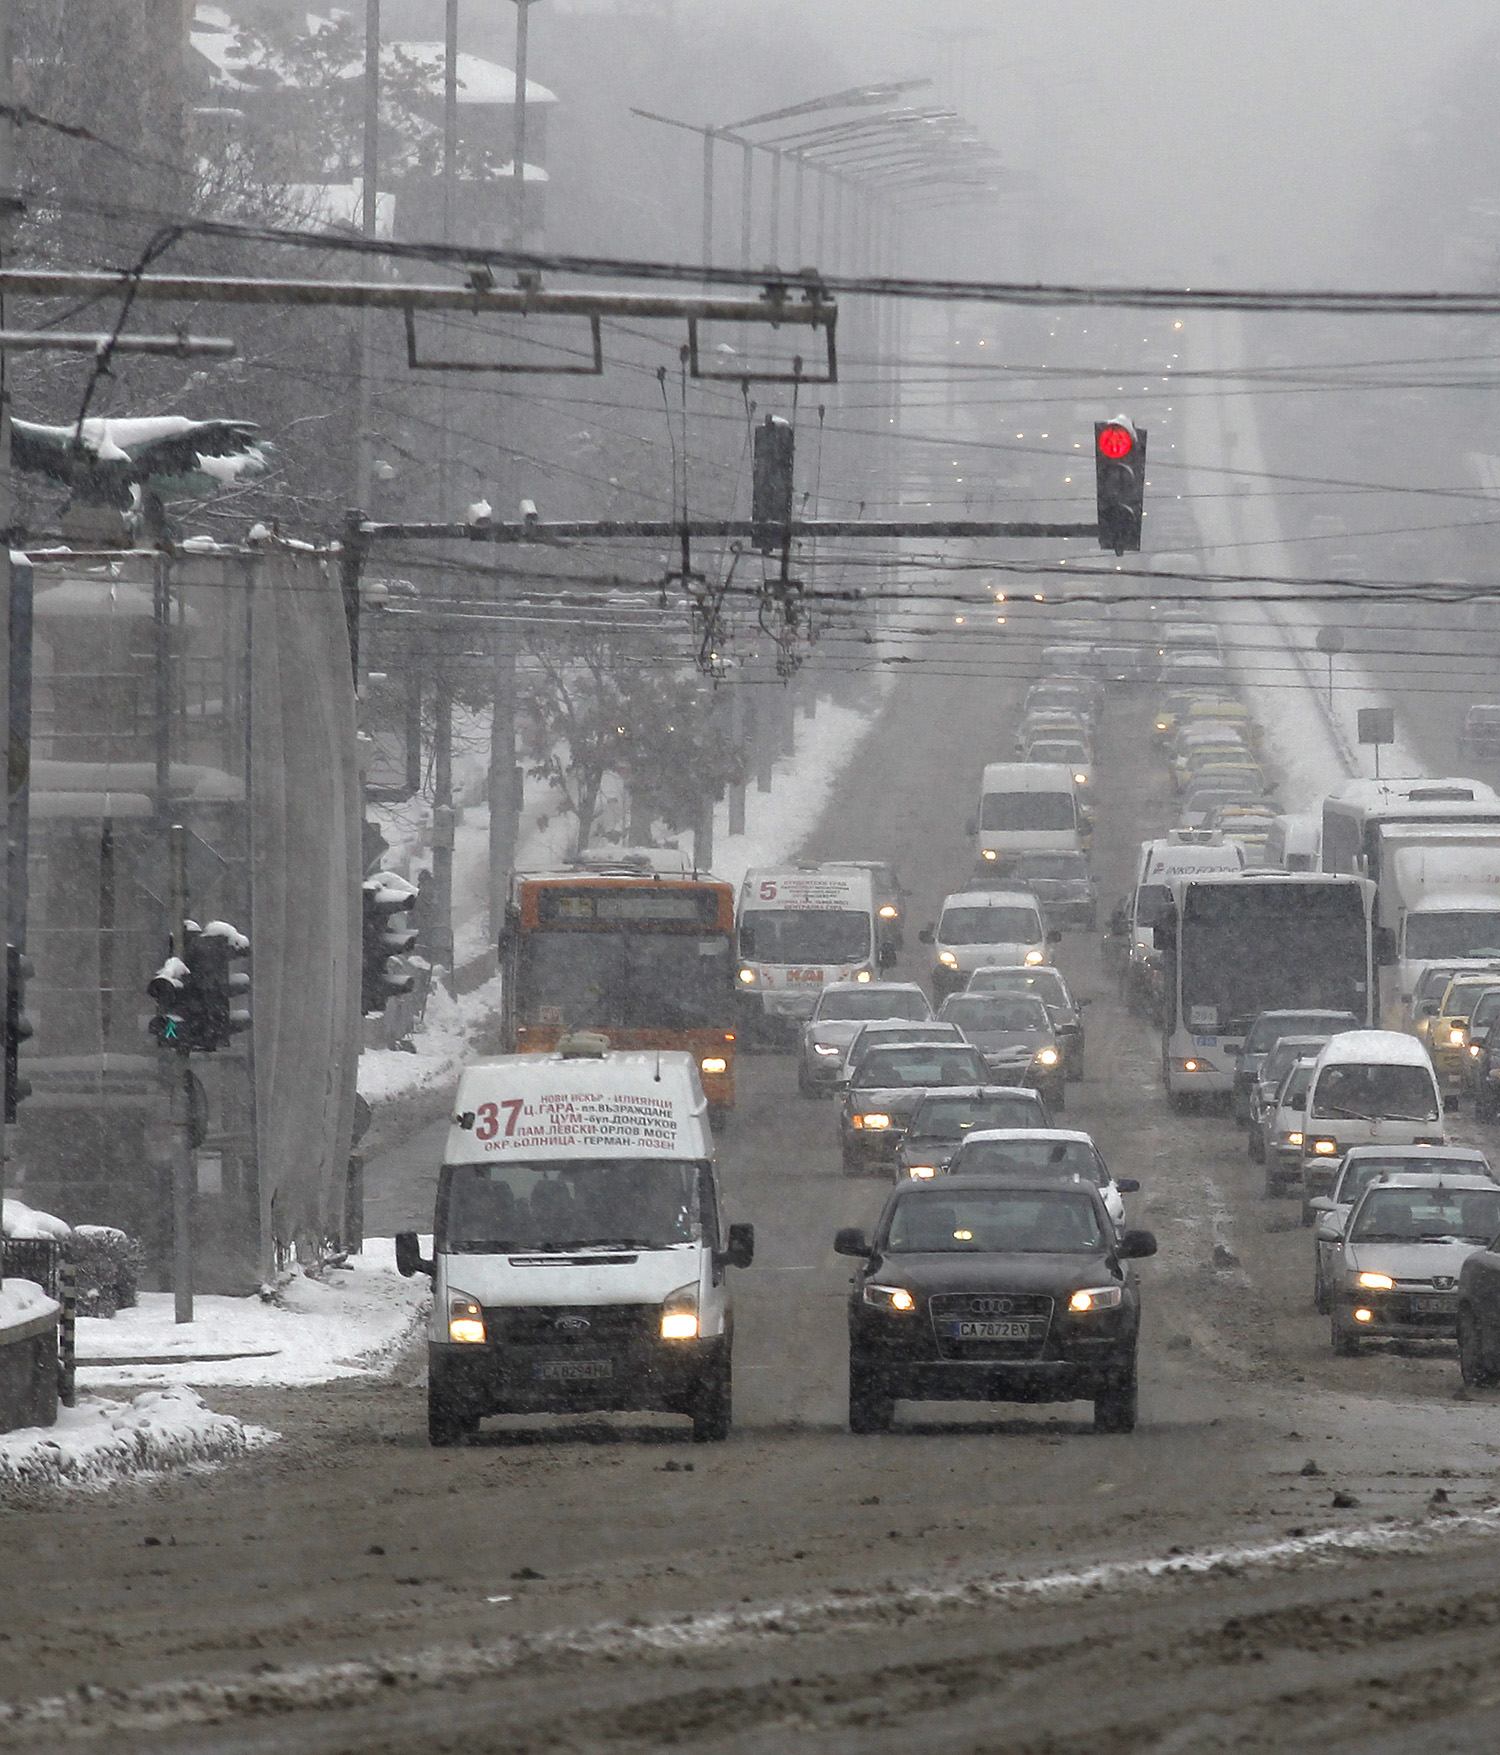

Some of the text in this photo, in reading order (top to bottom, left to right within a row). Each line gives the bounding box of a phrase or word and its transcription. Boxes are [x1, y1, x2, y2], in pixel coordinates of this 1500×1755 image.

[760, 881, 777, 900] 5
[476, 1099, 524, 1140] 37
[643, 1128, 677, 1140] МОСТ
[584, 1136, 630, 1146] ГЕРМАН
[637, 1138, 675, 1150] ЛОЗЕН
